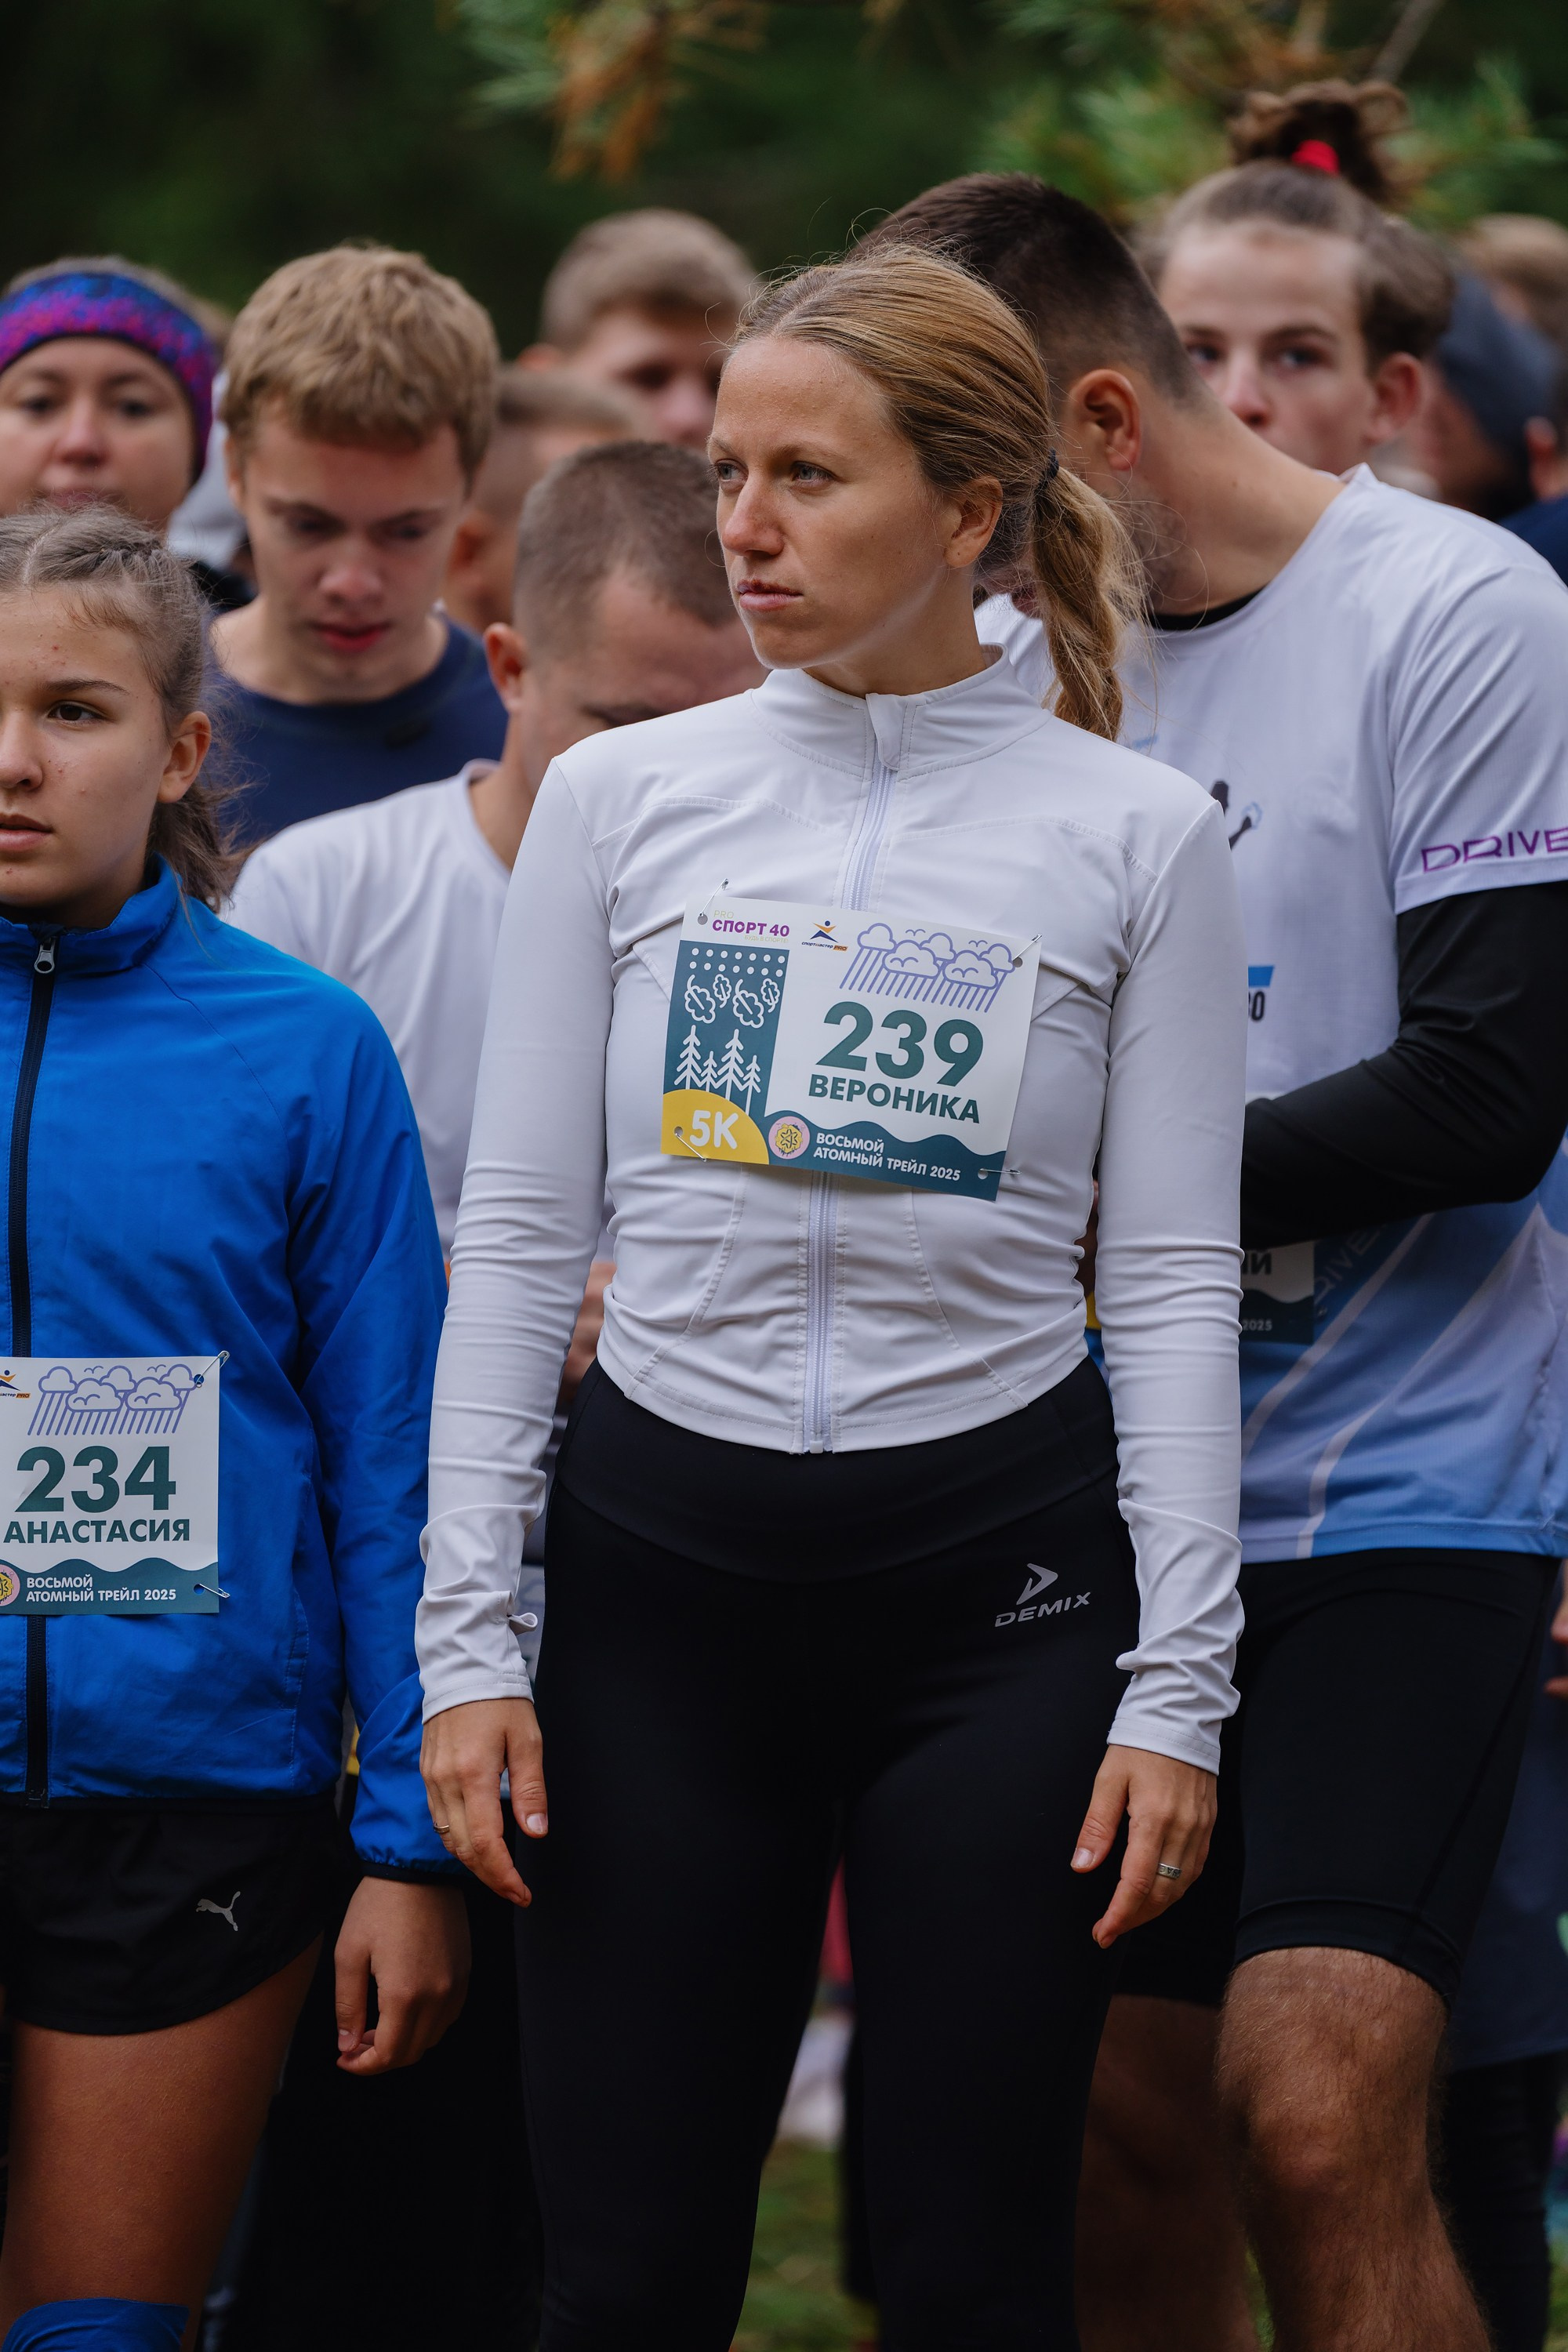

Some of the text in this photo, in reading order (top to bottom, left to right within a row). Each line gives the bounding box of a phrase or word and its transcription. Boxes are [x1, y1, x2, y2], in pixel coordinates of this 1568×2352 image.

[1421, 826, 1568, 873] DRIVE
[713, 910, 734, 919] PRO
[712, 920, 790, 937] СПОРТ 40
[815, 1000, 984, 1087] 239
[808, 1073, 980, 1124] ВЕРОНИКА
[816, 1132, 884, 1154] ВОСЬМОЙ
[813, 1146, 961, 1181] АТОМНЫЙ ТРЕЙЛ 2025
[1242, 1318, 1273, 1332] 2025
[14, 1445, 176, 1513] 234
[3, 1519, 191, 1544] АНАСТАСИЯ
[27, 1573, 93, 1589] ВОСЬМОЙ
[26, 1587, 176, 1602] АТОМНЫЙ ТРЕЙЛ 2025
[995, 1592, 1091, 1628] DEMIX
